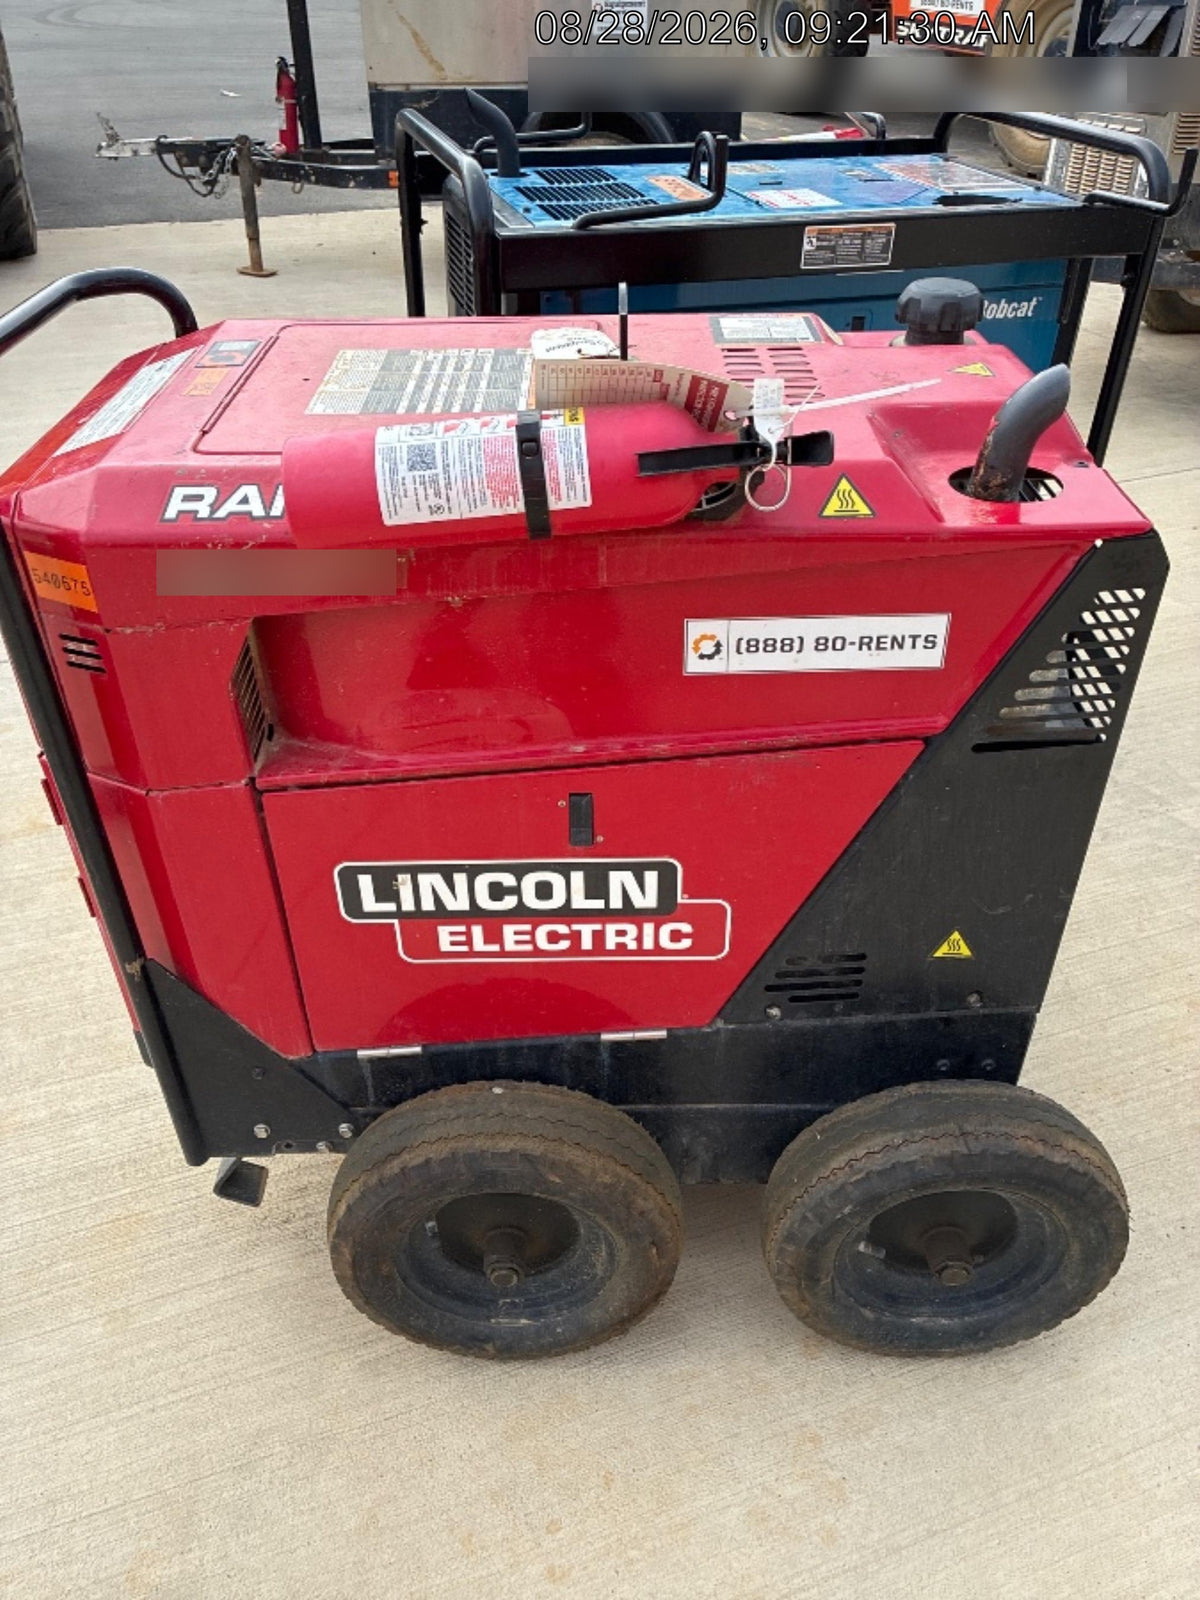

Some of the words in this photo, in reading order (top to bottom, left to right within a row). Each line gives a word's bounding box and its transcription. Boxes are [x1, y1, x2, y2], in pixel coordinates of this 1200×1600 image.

[32, 568, 91, 597] 540675
[735, 636, 804, 655] (888)
[814, 633, 938, 653] 80-RENTS
[356, 869, 660, 914] LINCOLN
[436, 921, 694, 953] ELECTRIC
